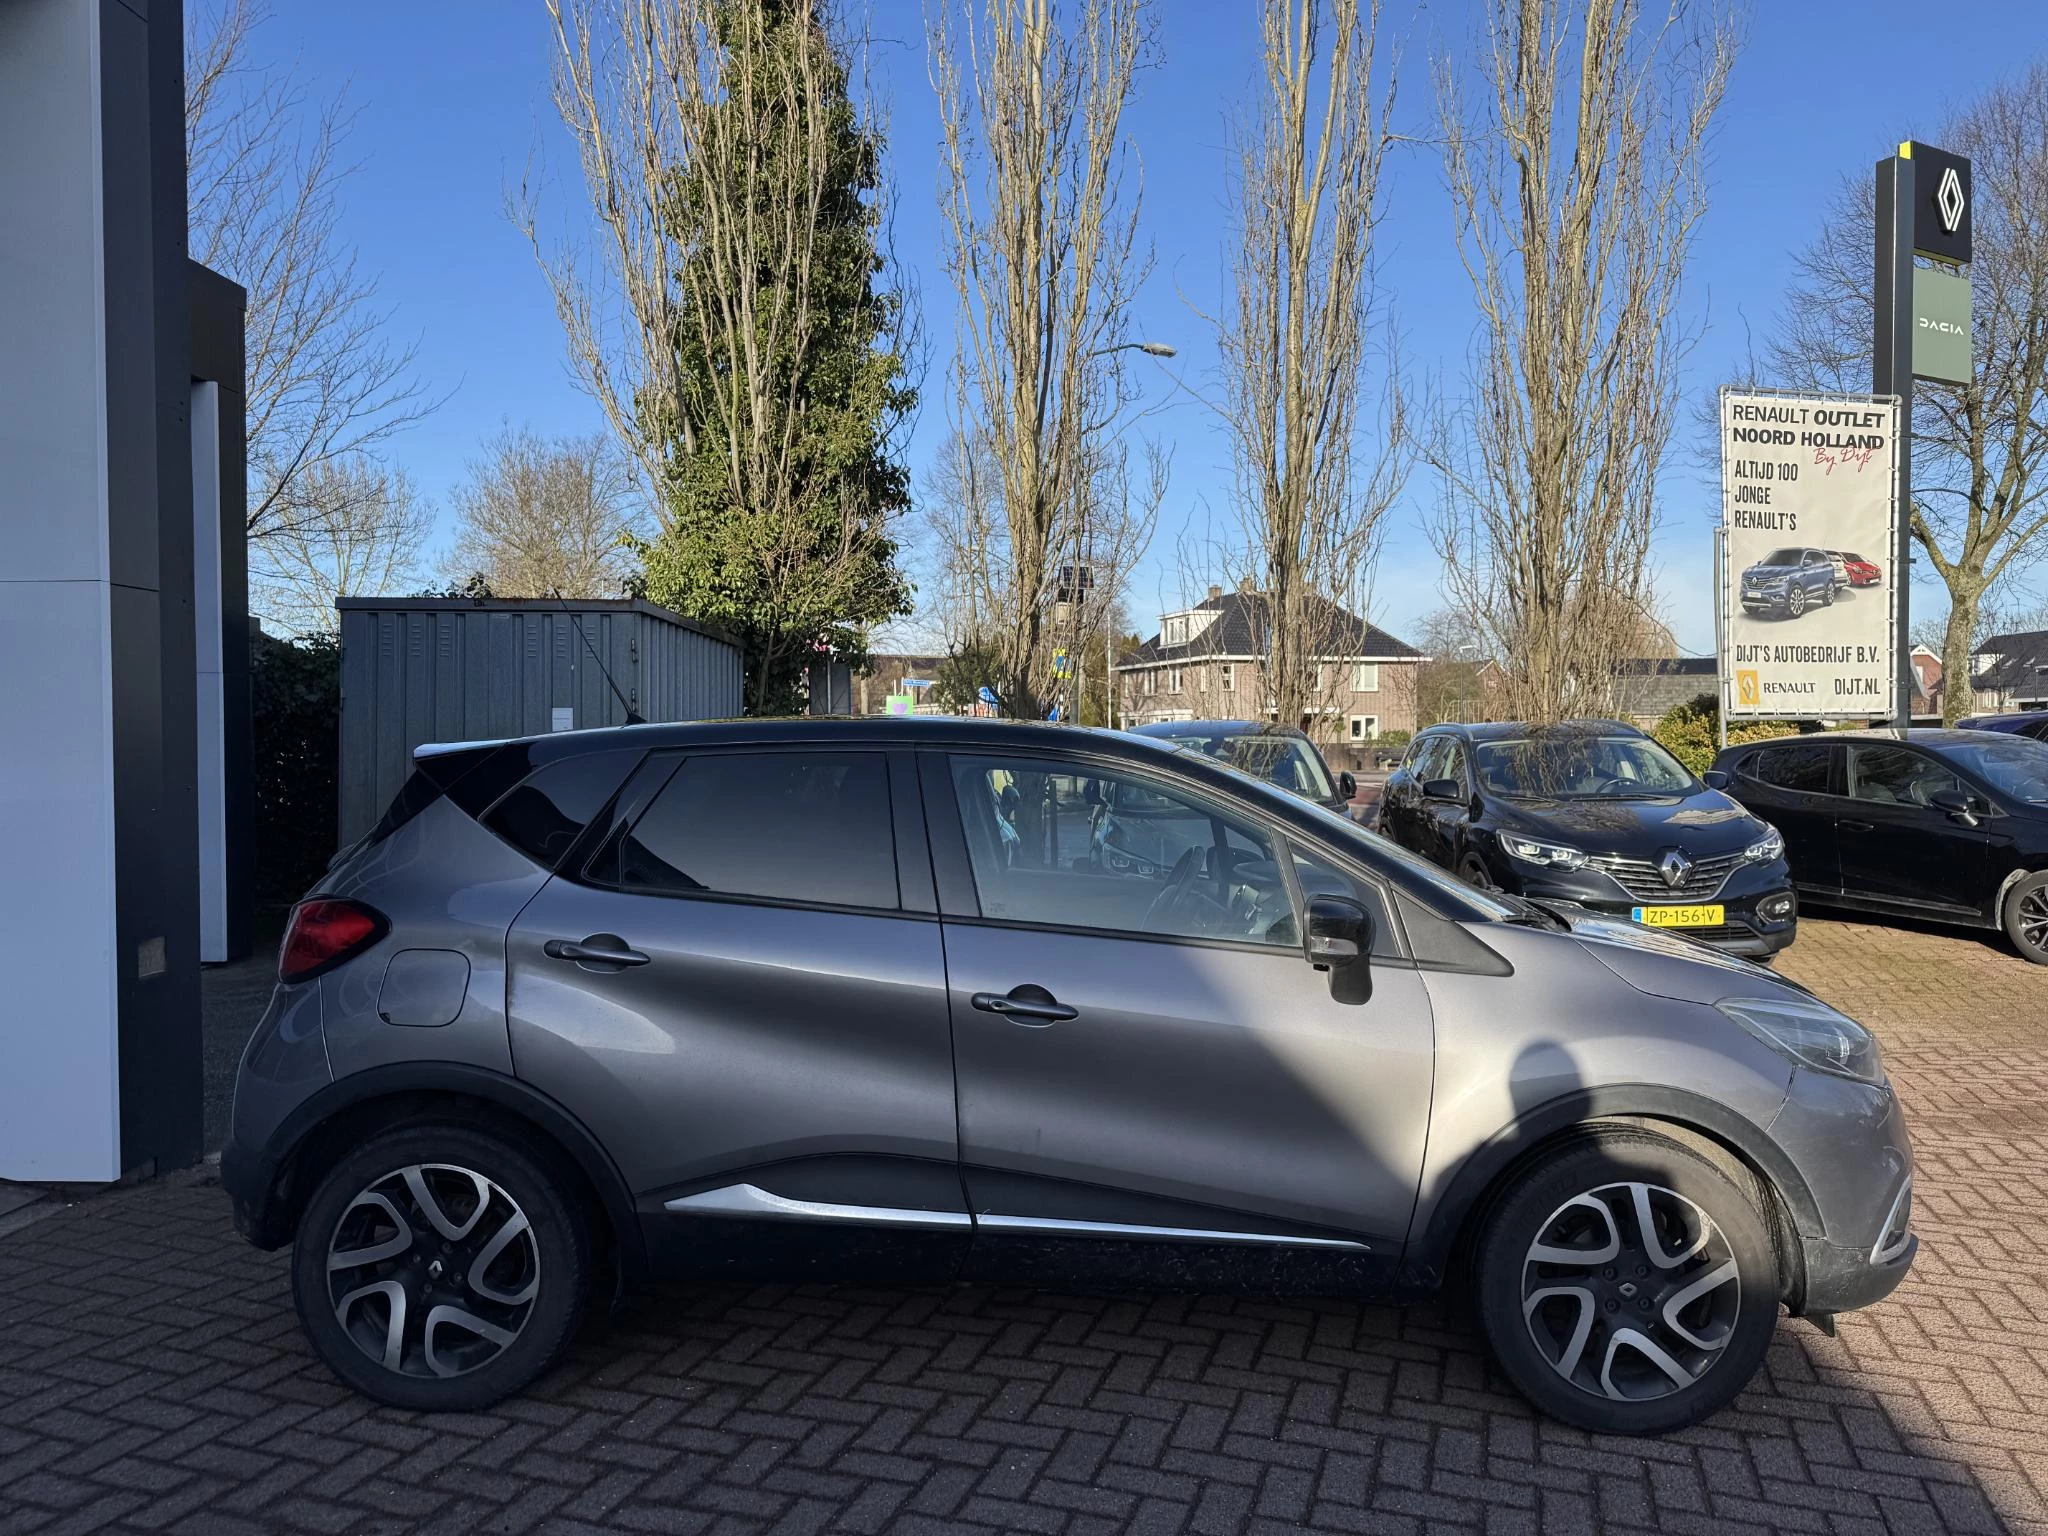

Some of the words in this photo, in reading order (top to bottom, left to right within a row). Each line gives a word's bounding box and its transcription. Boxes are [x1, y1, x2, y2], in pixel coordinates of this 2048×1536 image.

[1919, 317, 1964, 335] DACIA
[1733, 404, 1809, 425] RENAULT
[1814, 410, 1885, 428] OUTLET
[1733, 427, 1796, 446] NOORD
[1801, 432, 1885, 449] HOLLAND
[1735, 460, 1774, 480] ALTIJD
[1777, 463, 1799, 481] 100
[1814, 447, 1837, 476] By
[1734, 485, 1771, 505] JONGE
[1734, 510, 1797, 531] RENAULT'S
[1736, 644, 1771, 663] DIJT'S
[1774, 645, 1853, 663] AUTOBEDRIJF
[1857, 646, 1880, 663] B.V.
[1763, 682, 1816, 694] RENAULT
[1834, 678, 1881, 695] DIJT.NL
[1649, 909, 1715, 924] ZP-156-V
